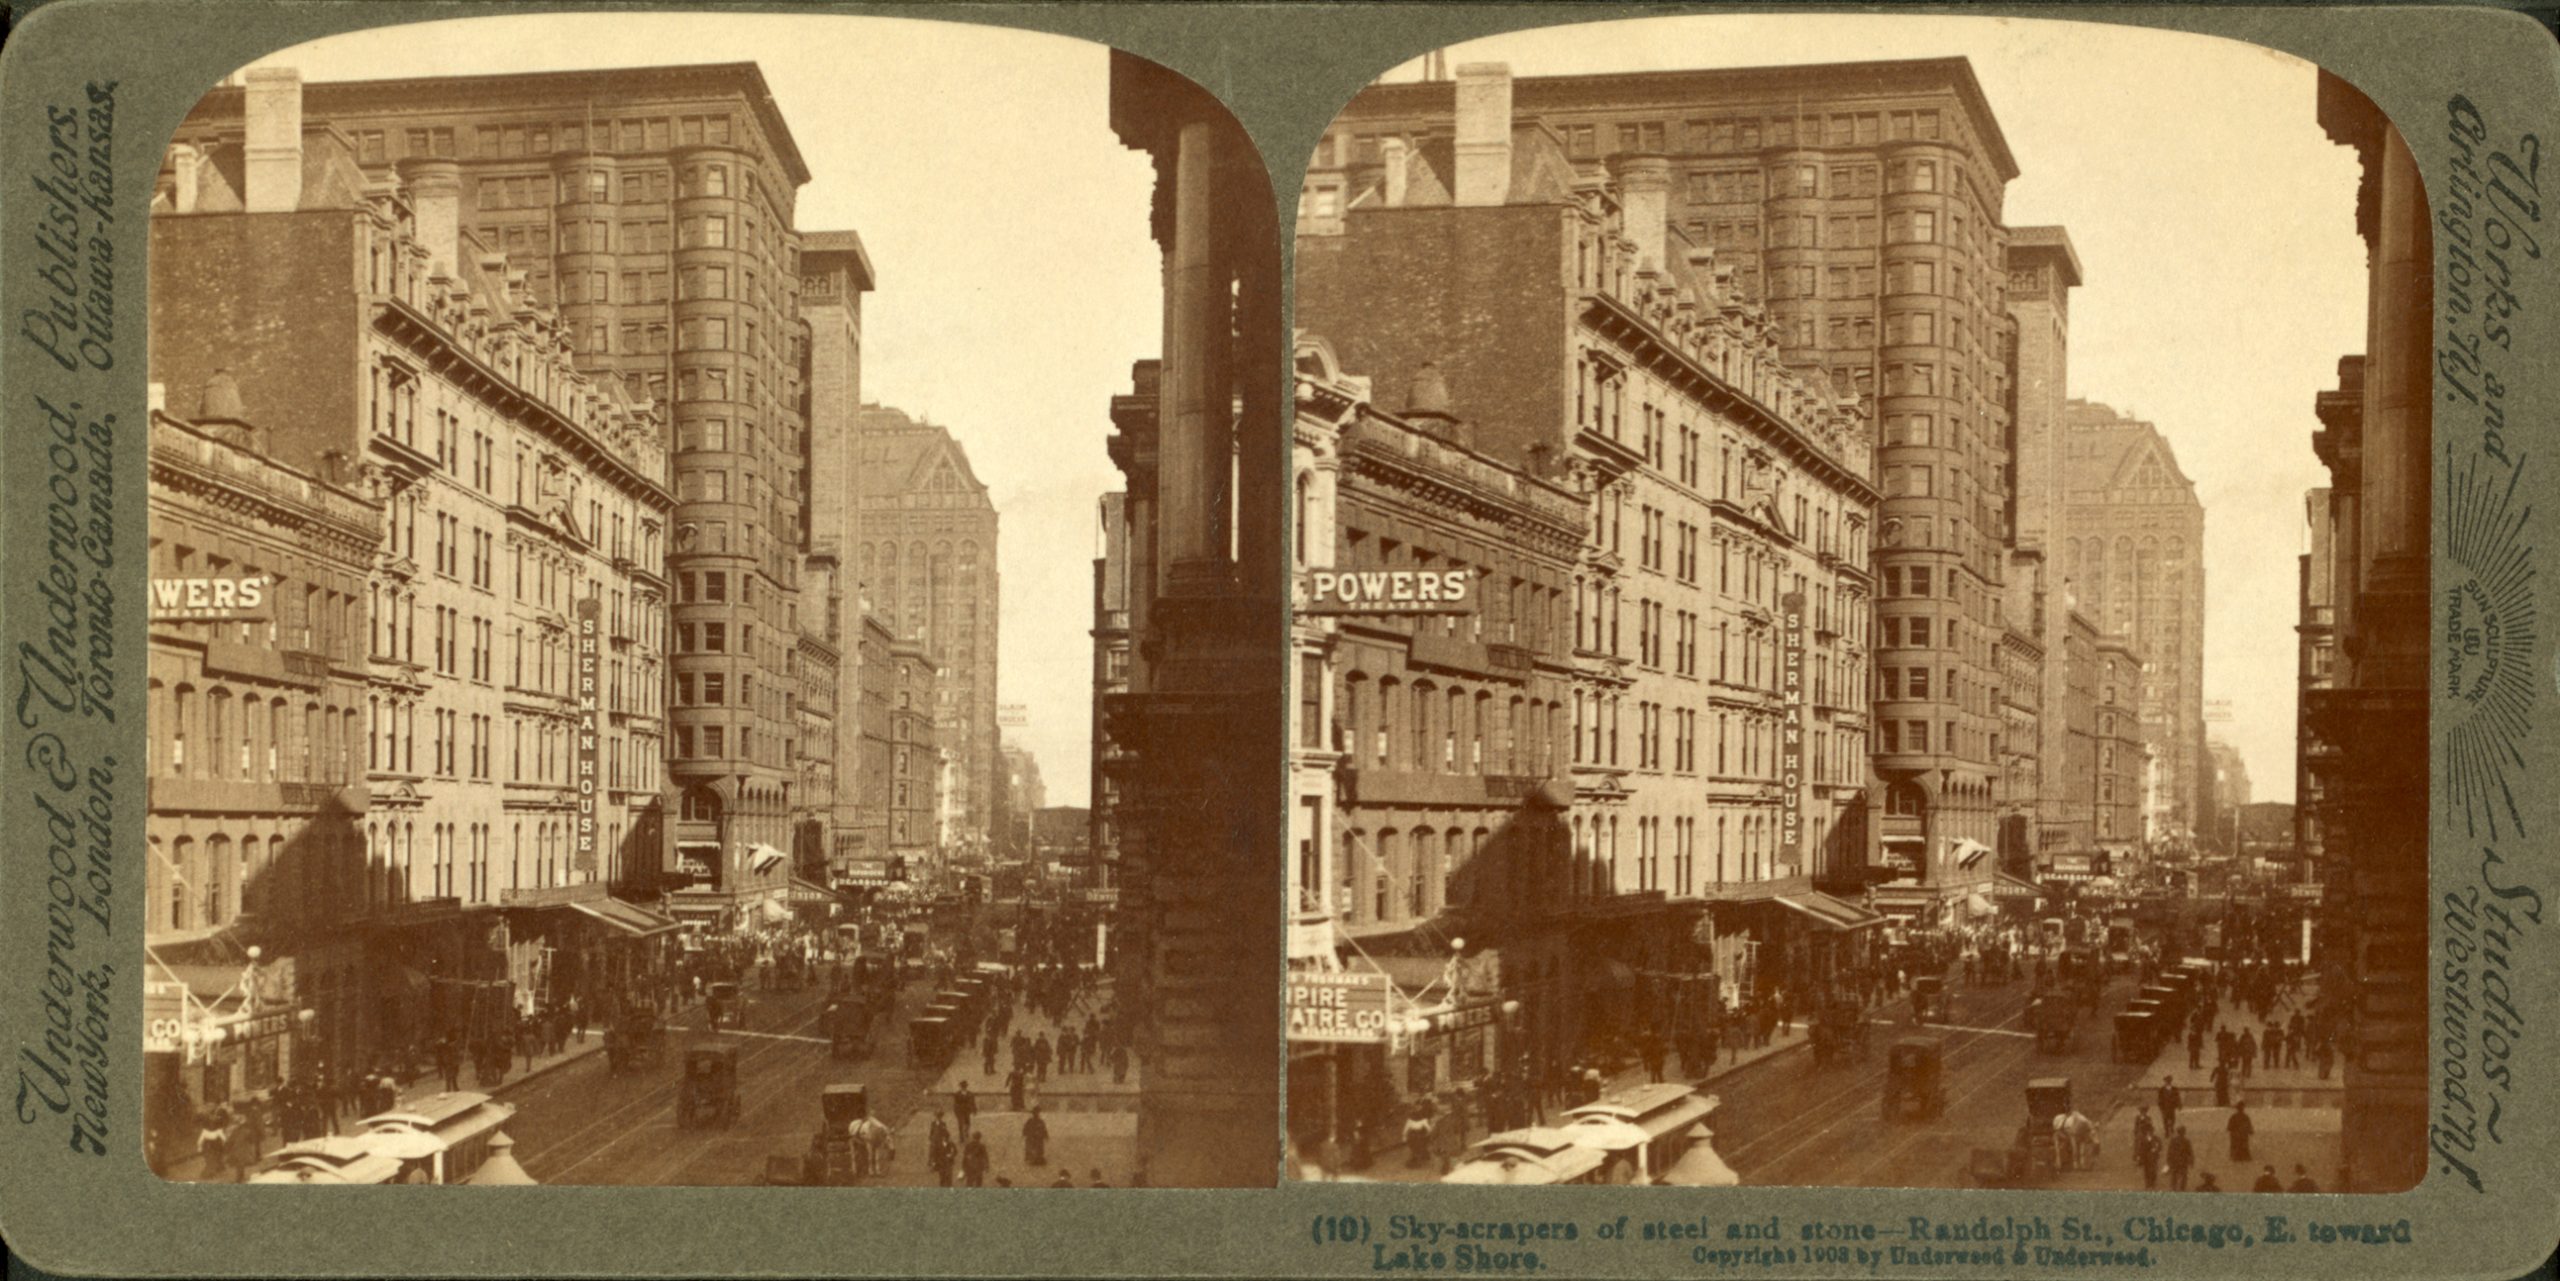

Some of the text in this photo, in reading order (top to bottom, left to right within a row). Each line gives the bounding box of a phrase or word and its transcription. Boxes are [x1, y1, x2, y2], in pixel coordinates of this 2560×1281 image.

[2483, 134, 2541, 468] Works and
[2448, 585, 2462, 643] TRADE
[2463, 579, 2500, 708] SUN SCULPTURE
[26, 732, 77, 791] &
[578, 619, 596, 851] SHERMAN HOUSE
[1783, 613, 1800, 845] SHERMAN HOUSE
[77, 755, 116, 936] London,
[16, 790, 77, 1124] Underwood
[2482, 847, 2542, 1092] Studios
[1312, 1216, 1372, 1243] (10)
[1388, 1216, 1578, 1244] Sky-scrapers
[1597, 1216, 1629, 1240] of
[1642, 1216, 1708, 1240] steel
[1726, 1216, 1780, 1240] and
[2123, 1216, 2254, 1247] Chicago,
[2263, 1216, 2296, 1243] E.
[2308, 1219, 2411, 1244] toward
[1373, 1244, 1548, 1270] Lake Shore.
[1693, 1246, 1797, 1268] Copyright
[1857, 1246, 1882, 1272] by
[1890, 1246, 2004, 1266] Underwood
